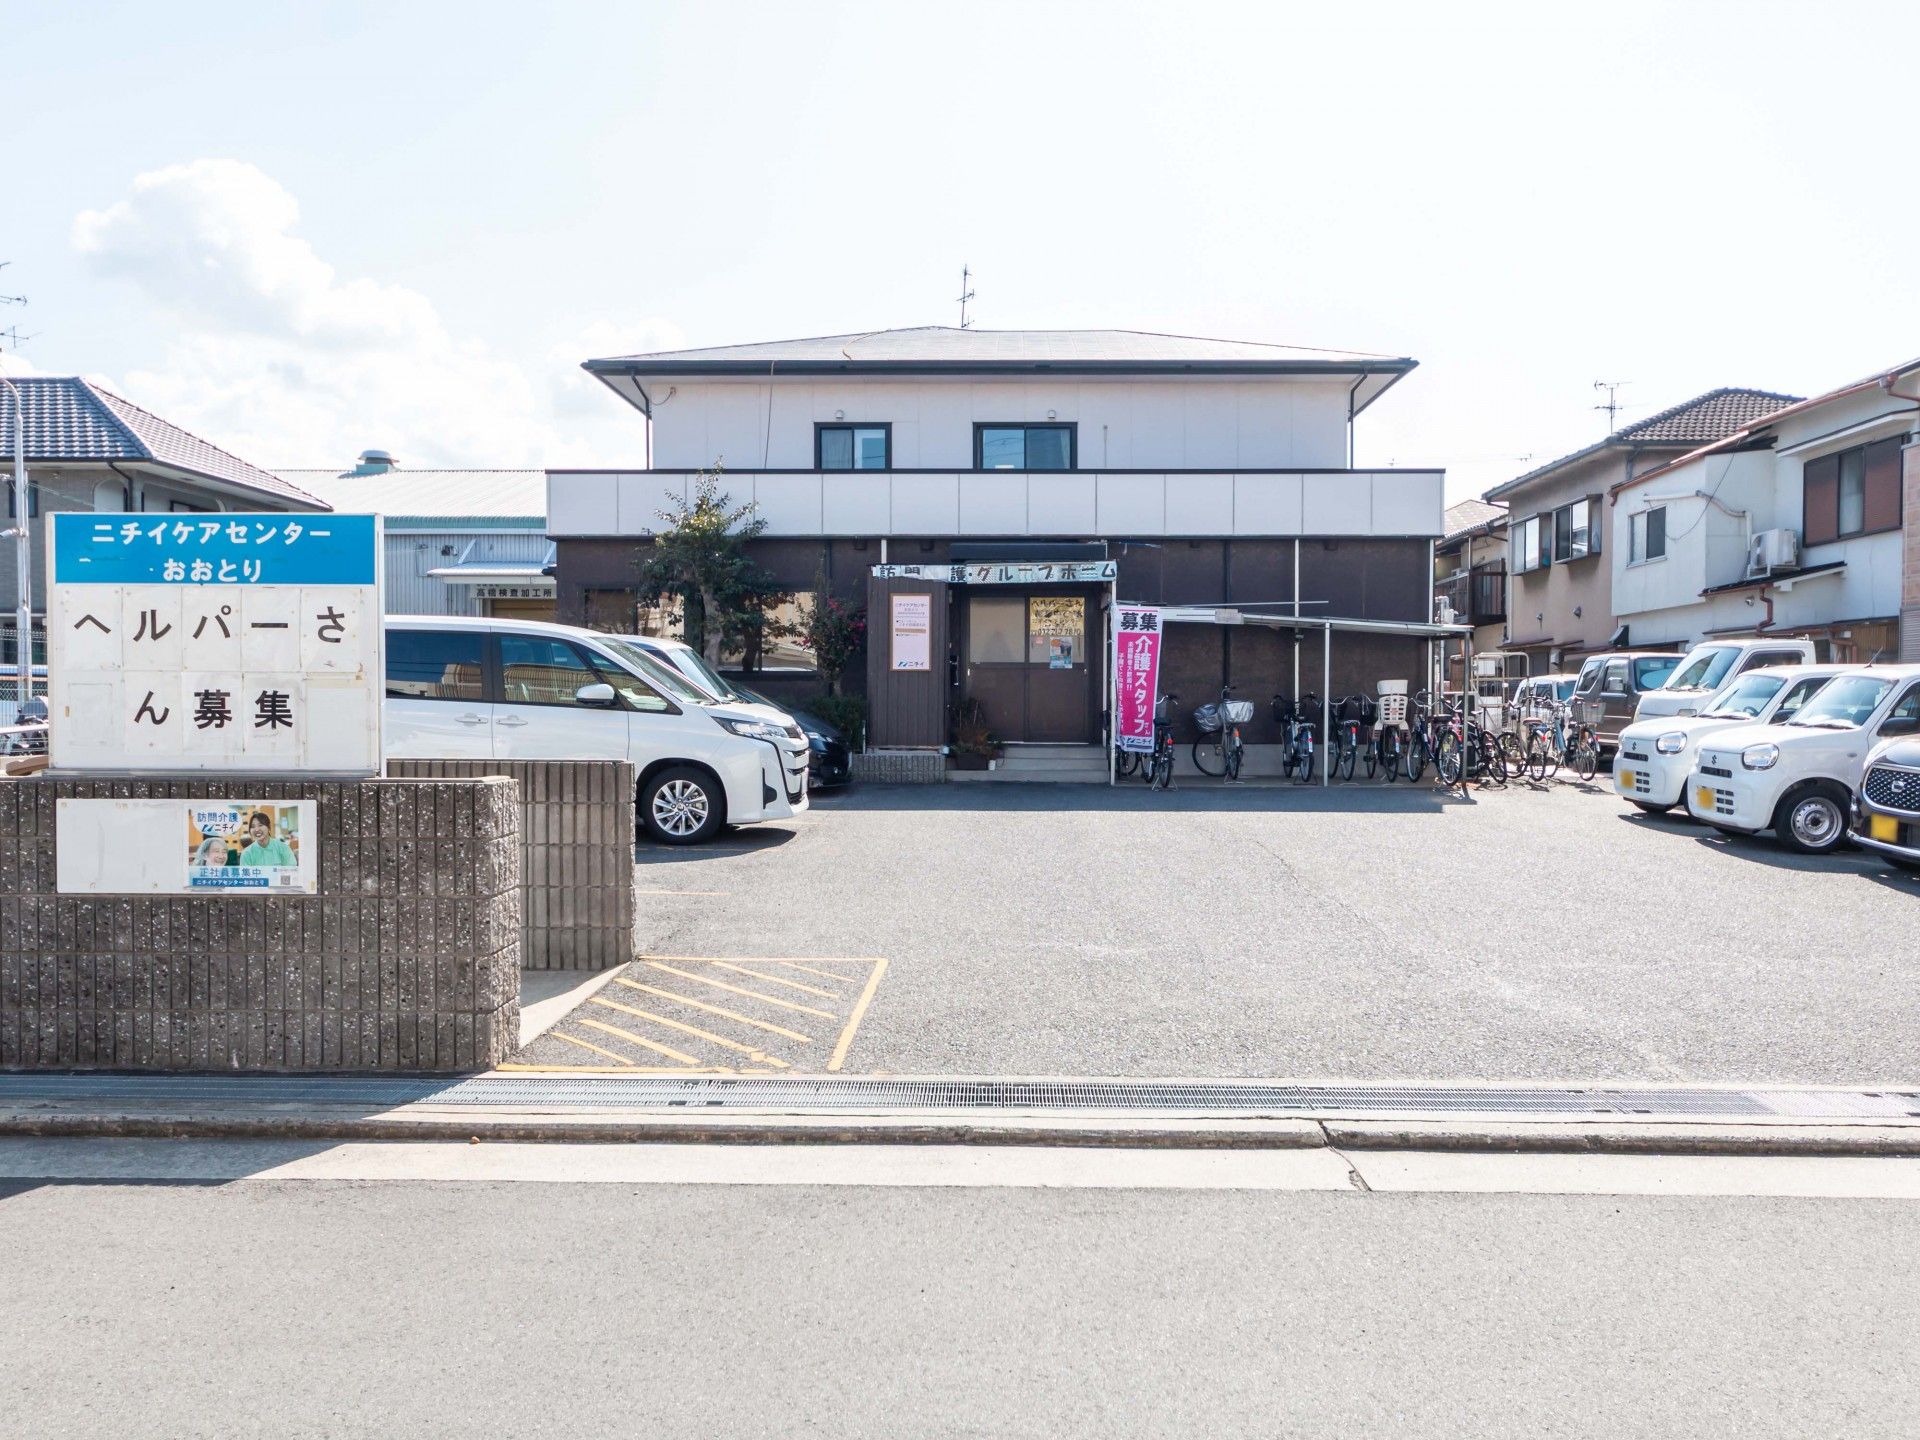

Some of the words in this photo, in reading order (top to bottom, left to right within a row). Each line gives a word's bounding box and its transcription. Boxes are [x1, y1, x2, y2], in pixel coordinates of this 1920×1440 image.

[92, 523, 331, 544] ニチイケアセンター
[163, 559, 262, 581] おおとり
[74, 604, 346, 643] ヘルパーさ
[1121, 612, 1157, 631] 募集
[1134, 635, 1153, 734] 介護スタッフ
[134, 689, 294, 730] ん募集
[197, 812, 239, 822] 訪問介護
[215, 824, 235, 832] ニチイ
[200, 868, 261, 877] 正社員募集中
